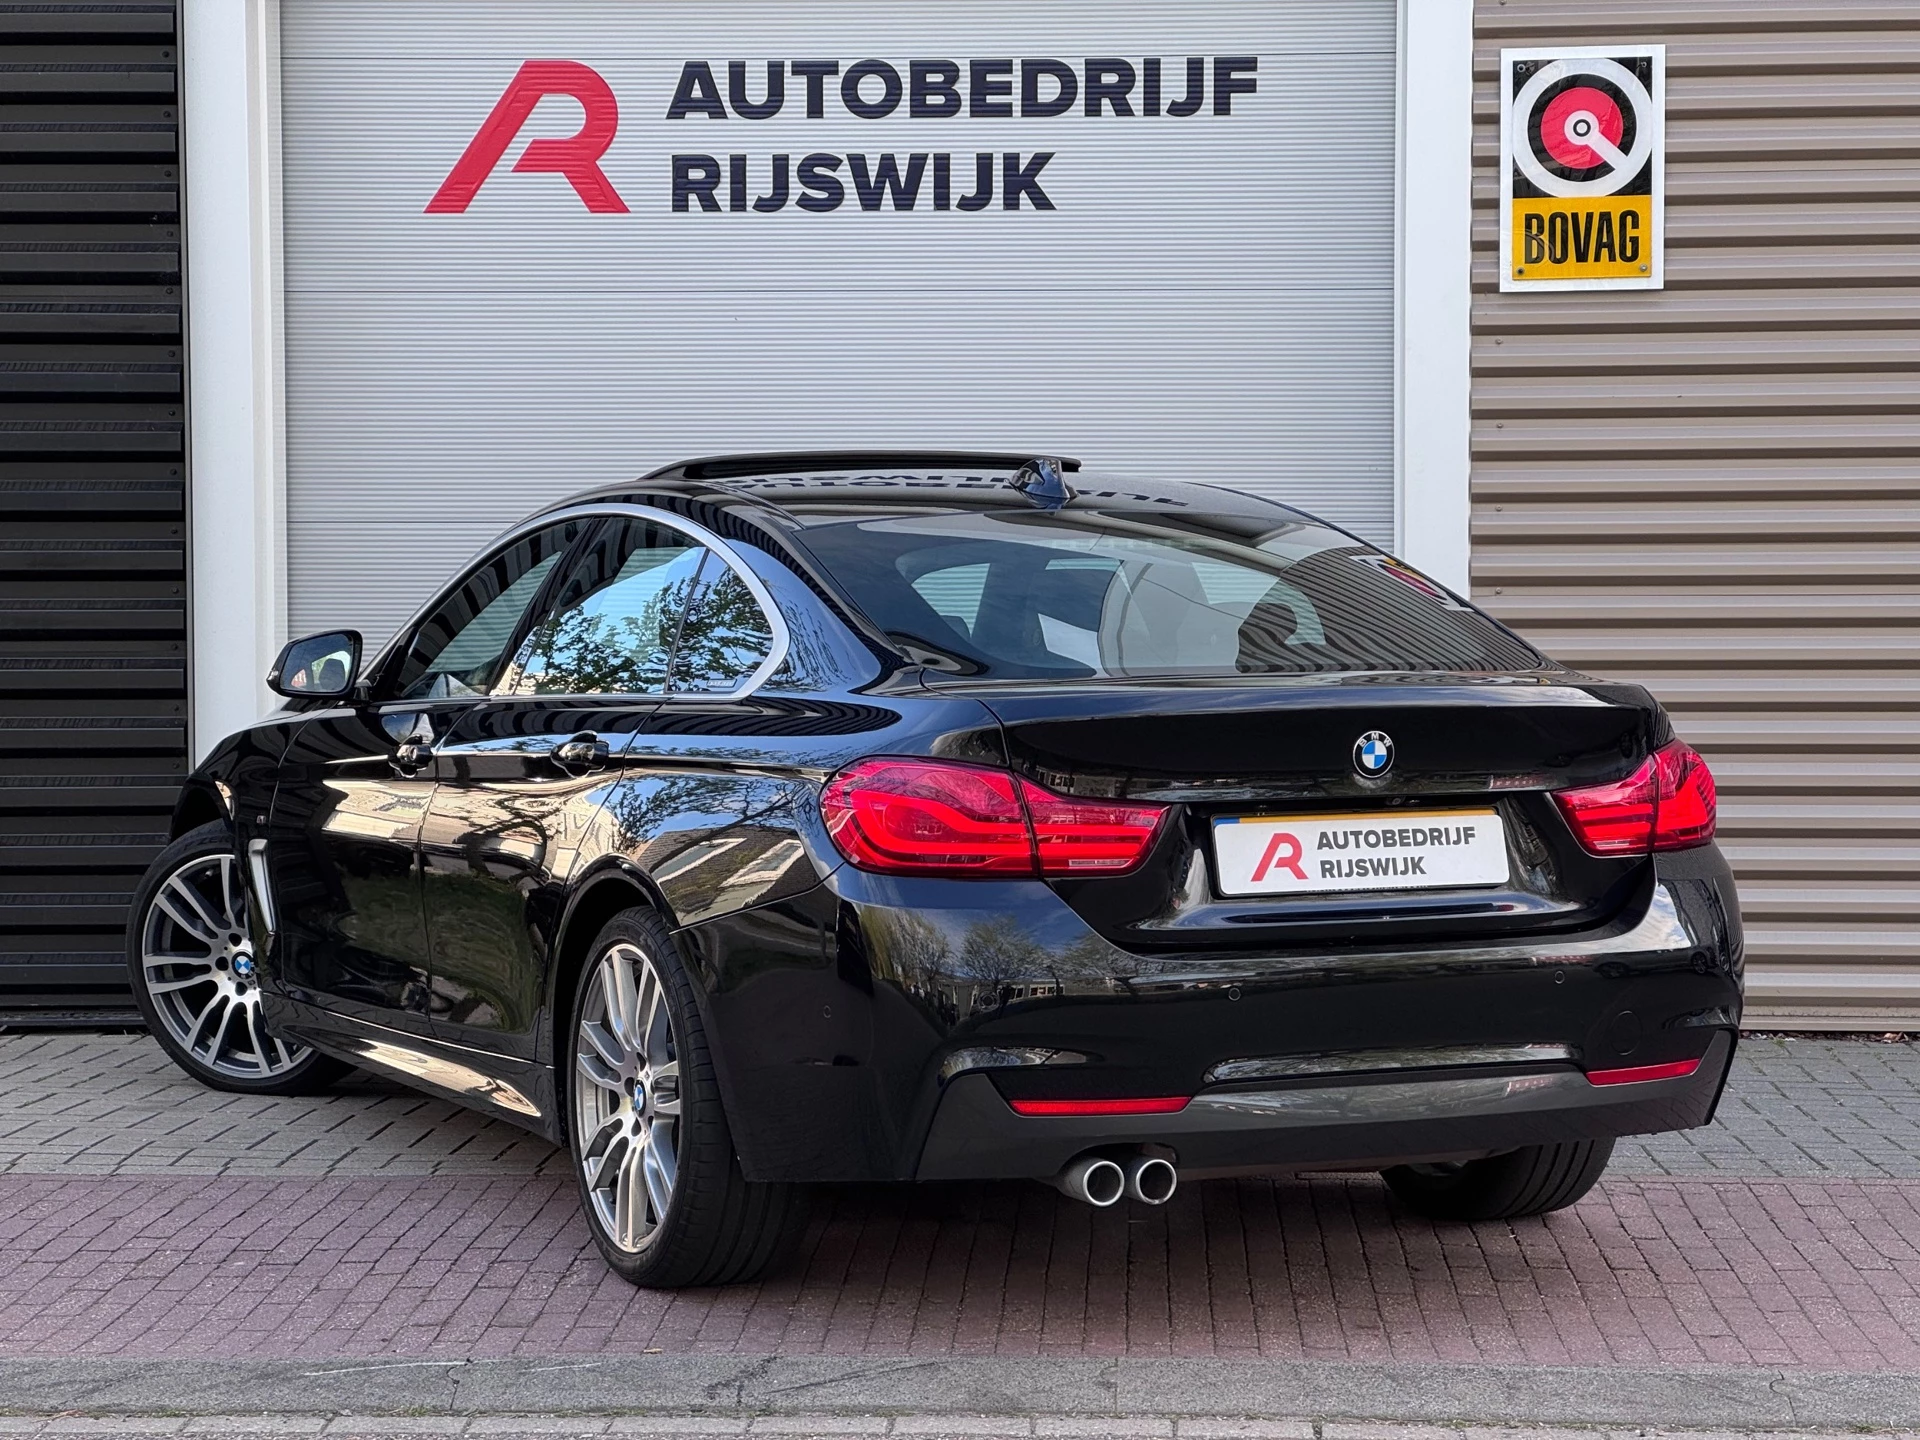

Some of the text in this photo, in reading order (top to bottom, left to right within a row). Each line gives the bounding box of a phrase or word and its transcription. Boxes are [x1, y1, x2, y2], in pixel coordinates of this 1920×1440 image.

[666, 57, 1258, 119] AUTOBEDRIJF
[672, 152, 1056, 213] RIJSWIJK
[1525, 210, 1640, 264] BOVAG
[1317, 826, 1476, 850] AUTOBEDRIJF
[1320, 856, 1427, 879] RIJSWIJK
